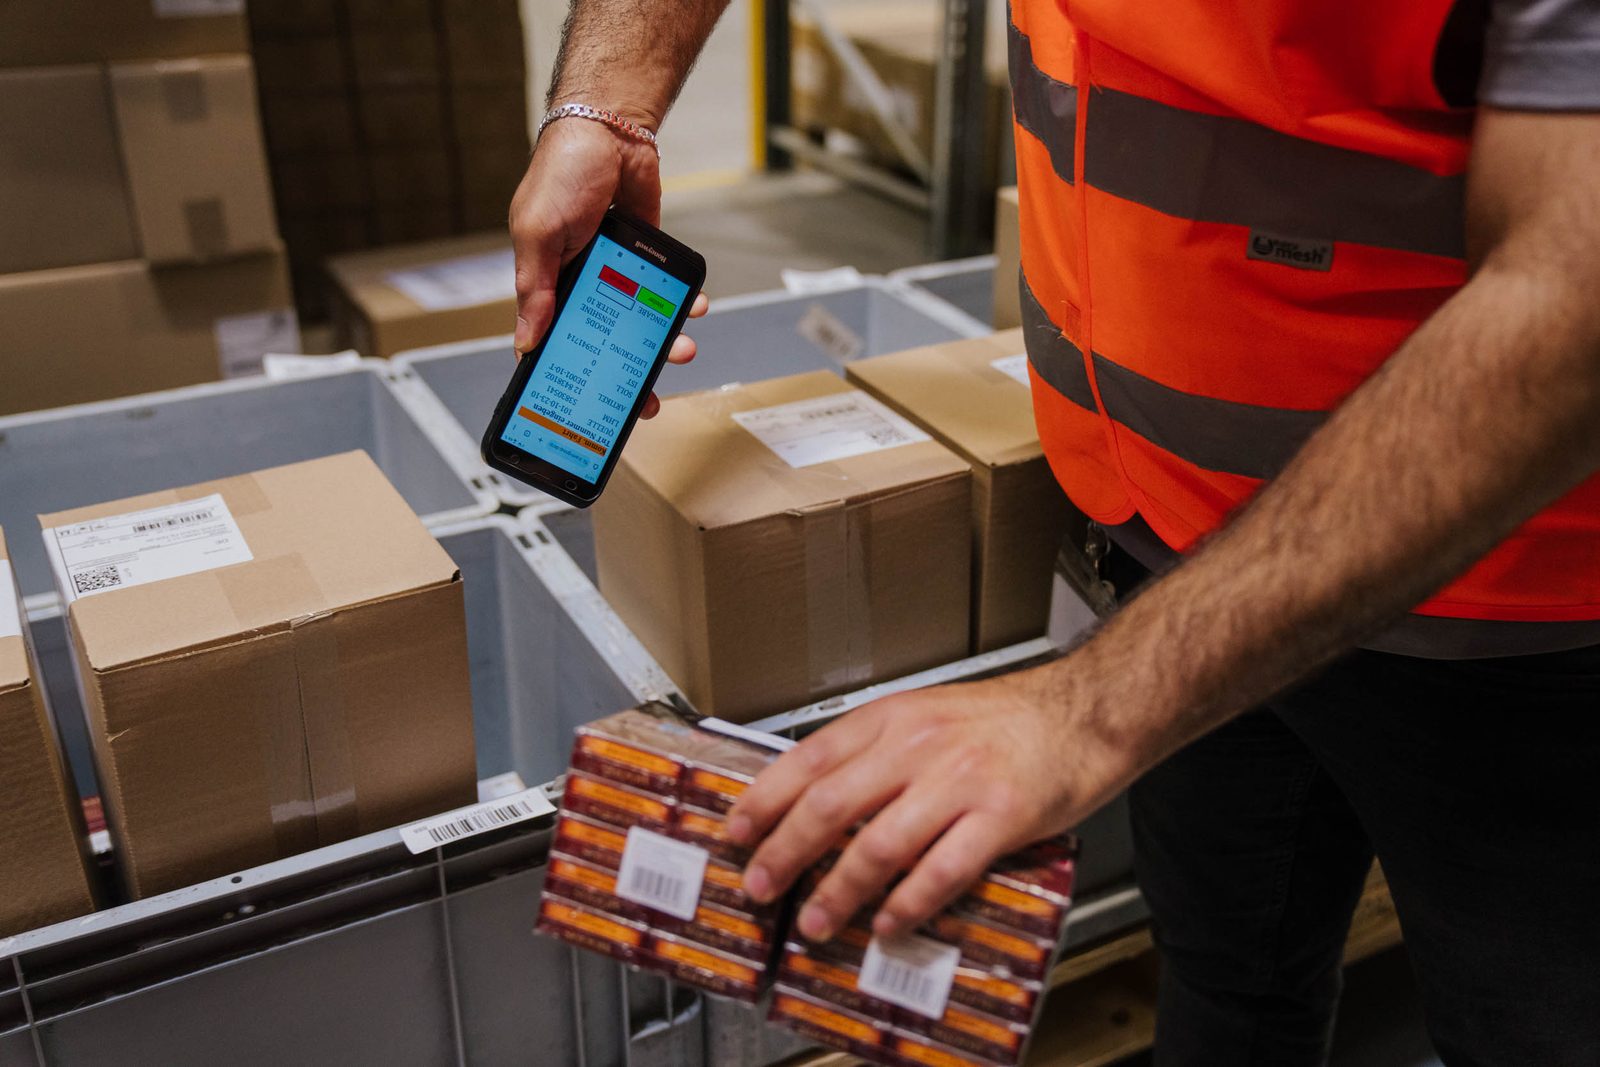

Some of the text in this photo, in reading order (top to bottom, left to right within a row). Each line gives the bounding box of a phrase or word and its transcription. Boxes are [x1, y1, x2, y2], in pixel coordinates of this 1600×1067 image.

[634, 240, 667, 263] Honeywell
[1276, 247, 1323, 264] mesh
[579, 303, 616, 327] SUNSHINE
[586, 296, 620, 318] FILTER 10
[636, 306, 668, 327] EINGABE
[585, 317, 612, 336] MOODS
[642, 338, 657, 350] BEZ
[609, 343, 648, 368] LIEFERUNG
[582, 367, 592, 376] 20
[622, 362, 643, 378] COLLI
[573, 386, 582, 395] 12
[614, 384, 633, 398] SOLL
[626, 378, 638, 388] IST
[530, 390, 572, 416] 101-10-23-10
[596, 393, 626, 412] ARTIKEL
[532, 402, 611, 447] TnT Nummer eingeben
[586, 418, 614, 437] QUELLE
[602, 414, 620, 427] LHM
[562, 429, 582, 443] Fahrt
